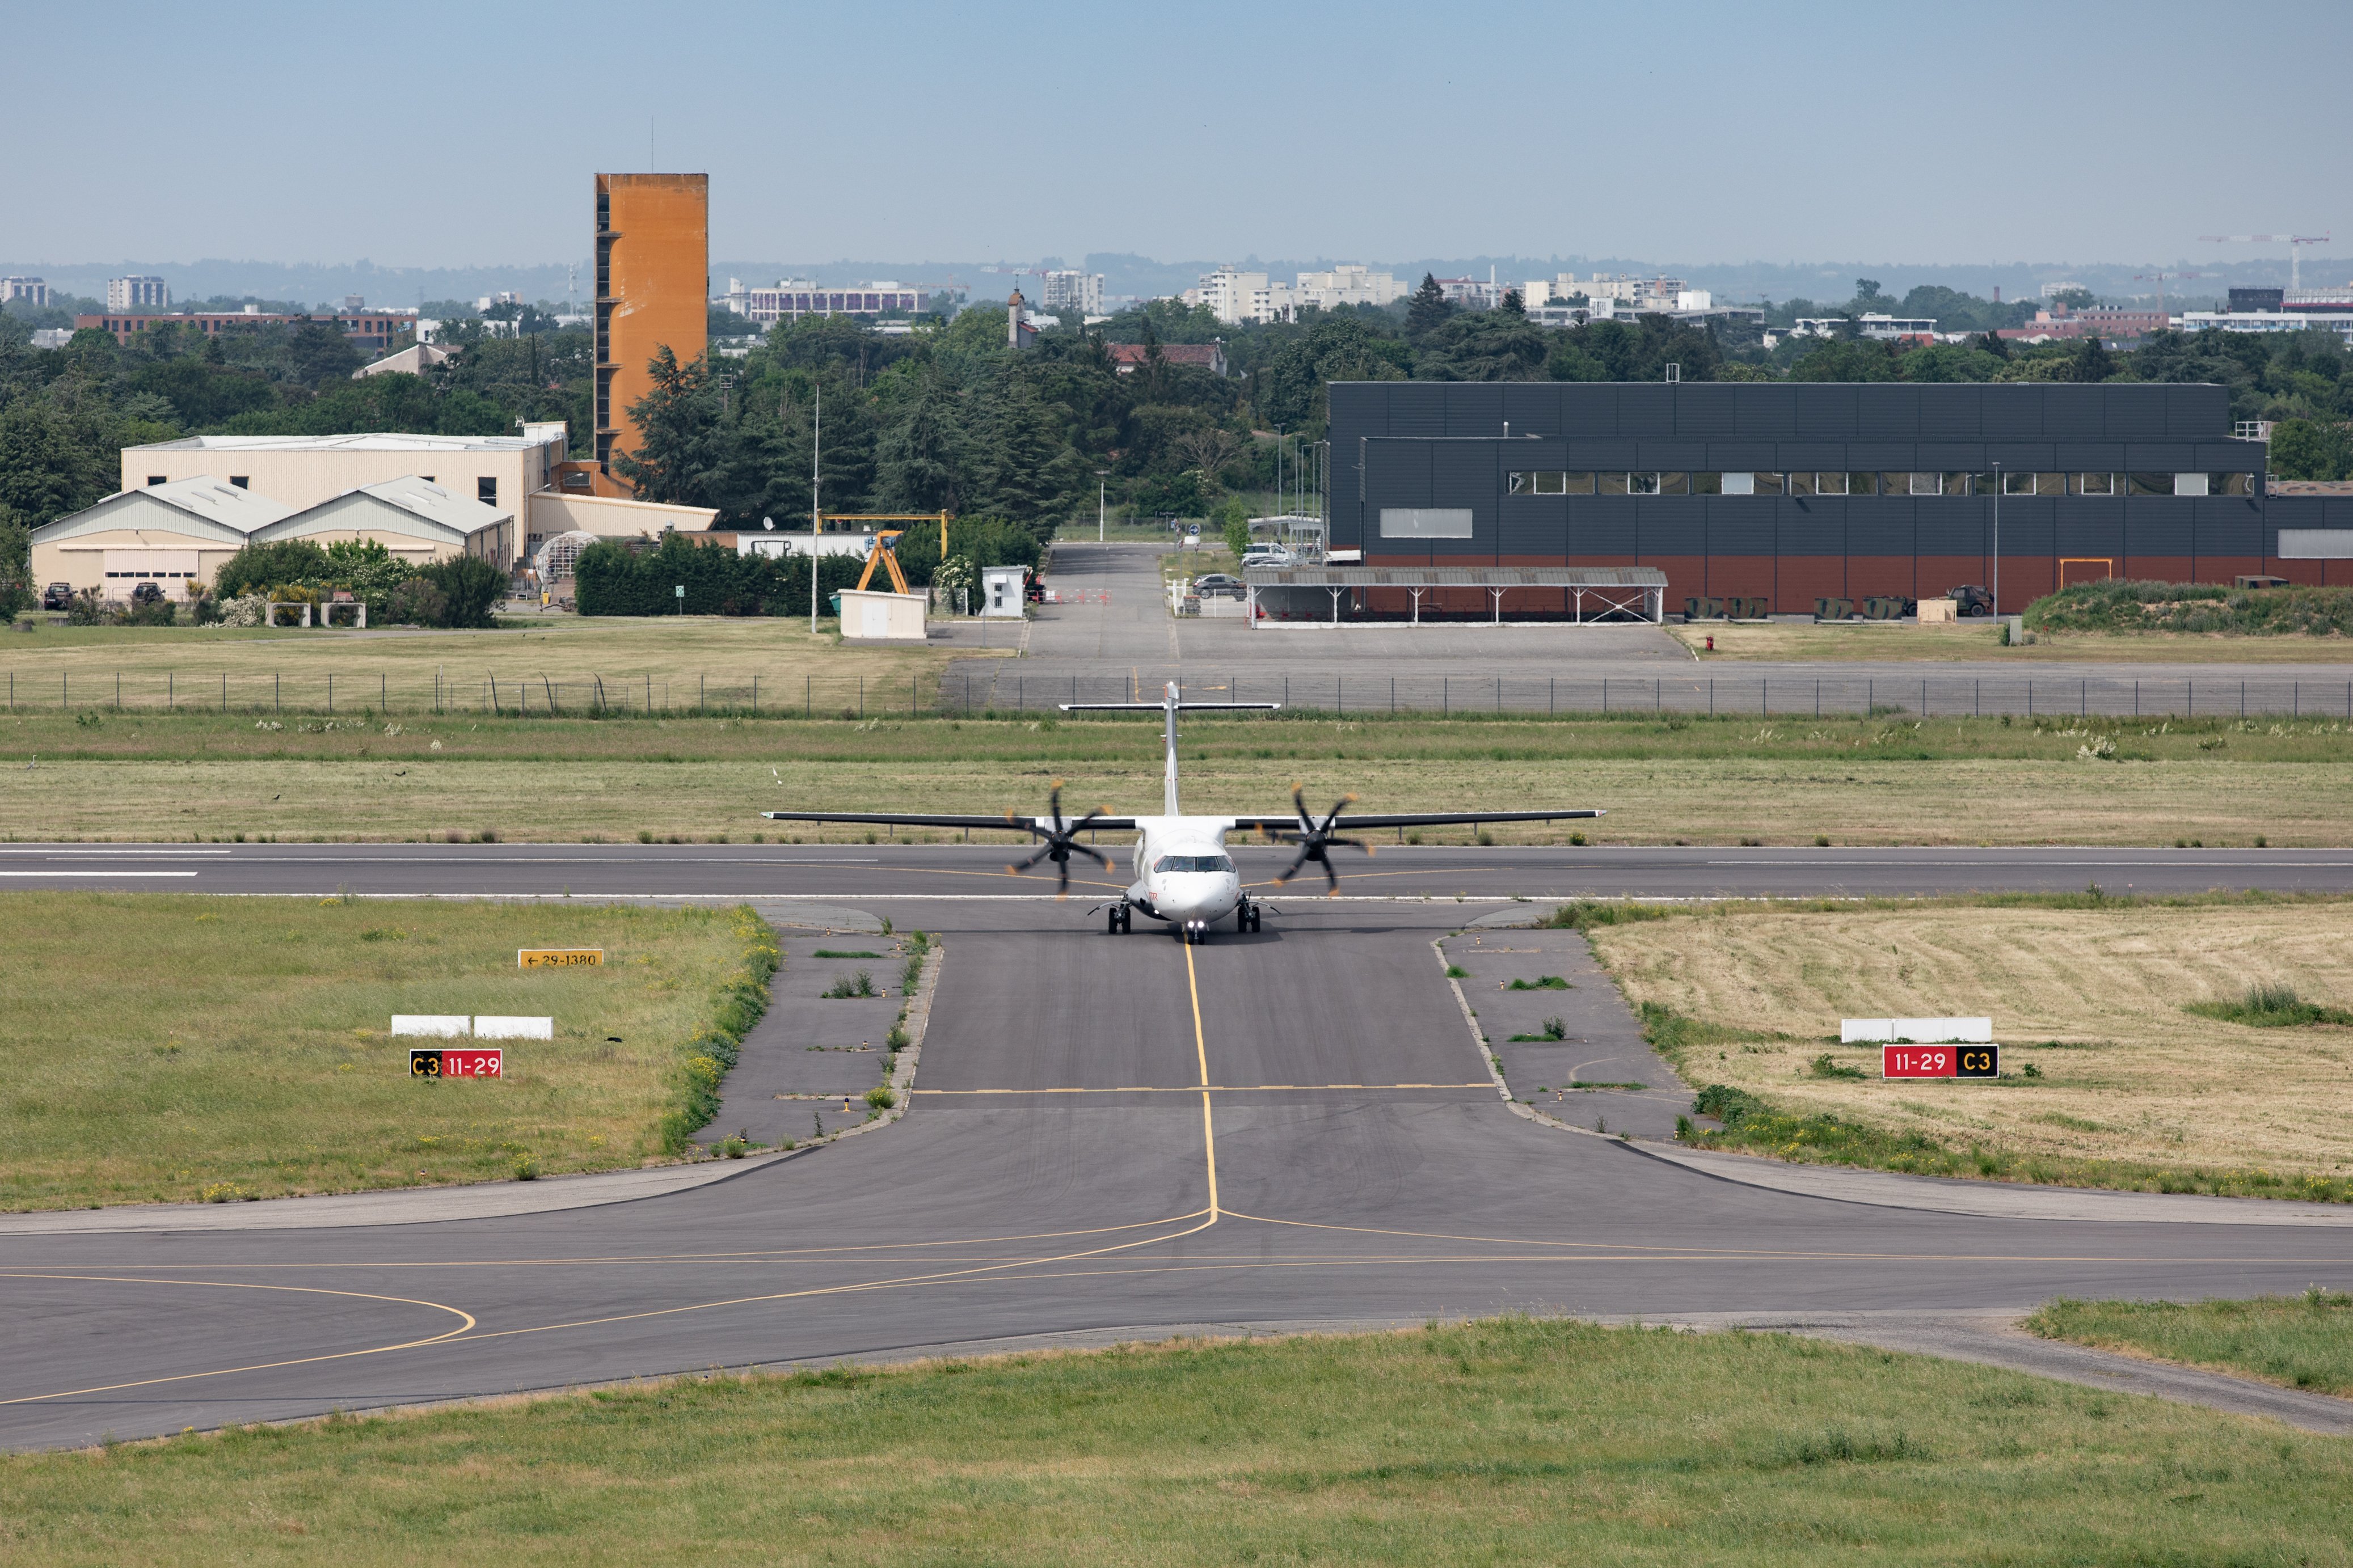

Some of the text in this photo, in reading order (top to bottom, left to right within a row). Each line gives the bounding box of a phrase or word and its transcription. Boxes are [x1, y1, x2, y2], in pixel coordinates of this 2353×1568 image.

[543, 955, 596, 966] 29-1380
[412, 1058, 499, 1075] C3 11-29
[1896, 1053, 1990, 1070] 11-29 C3
